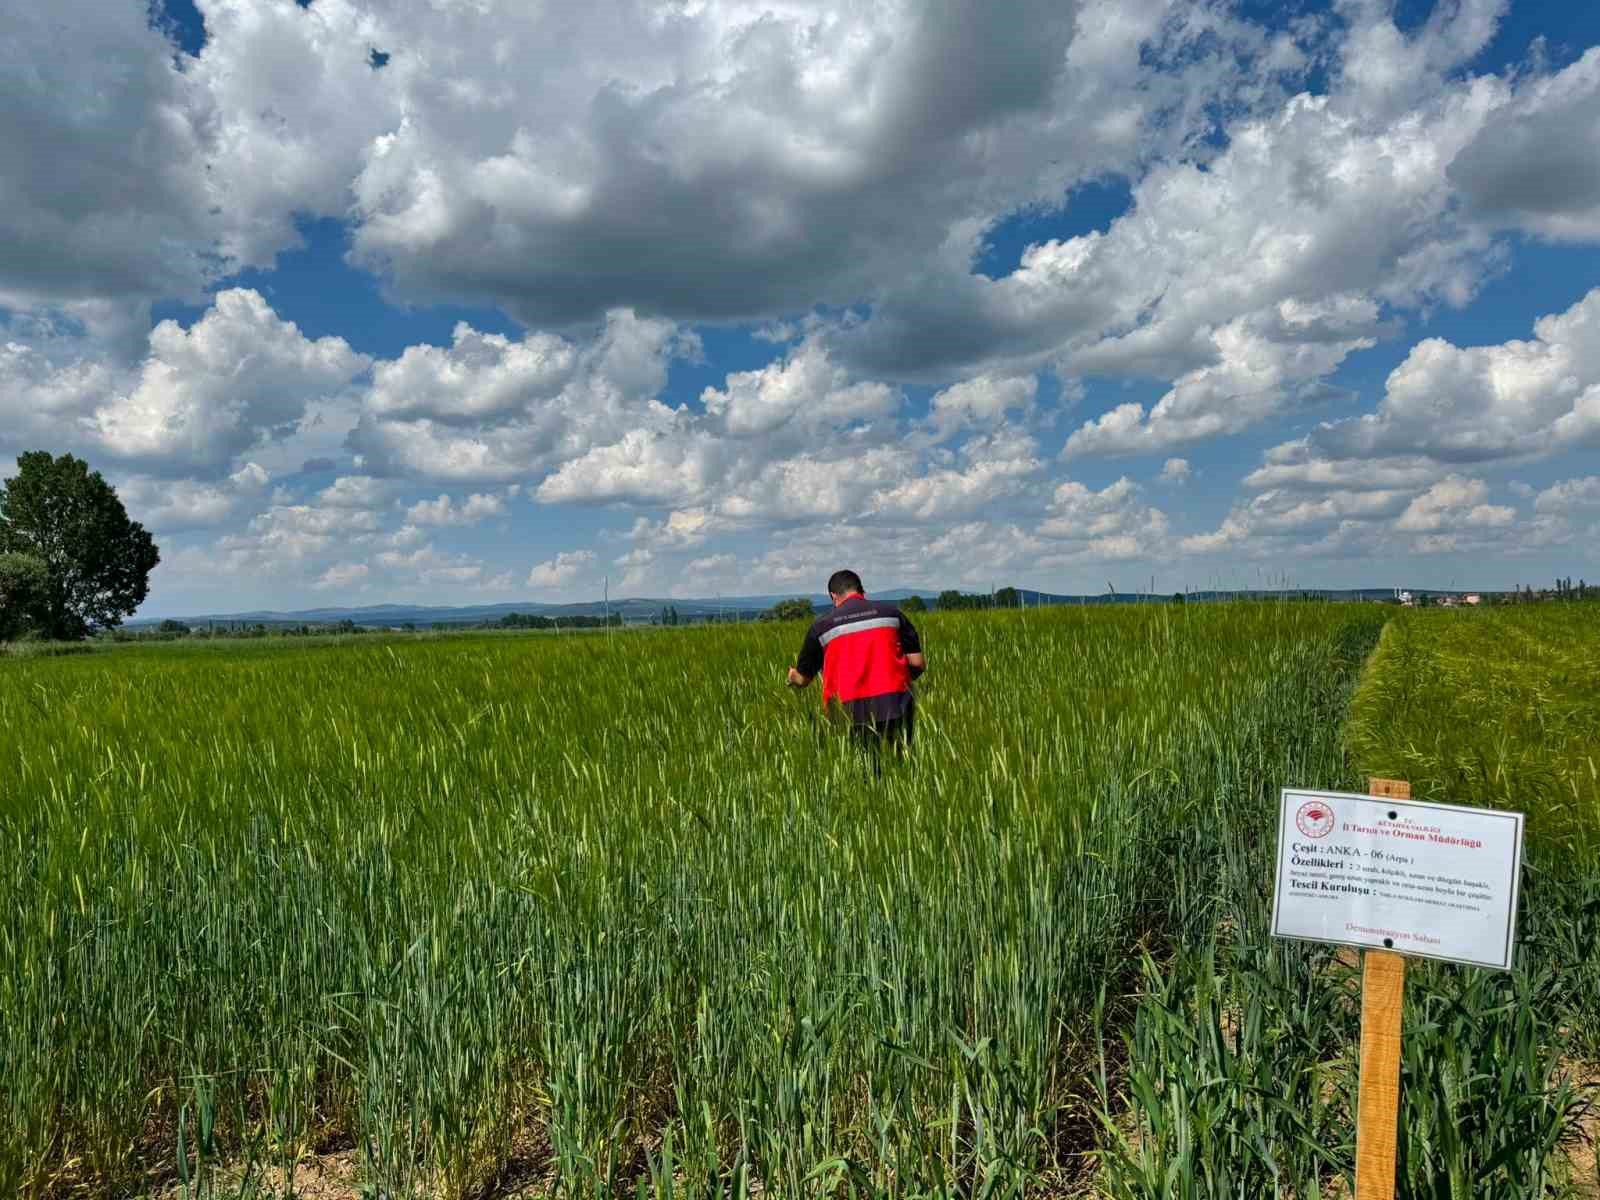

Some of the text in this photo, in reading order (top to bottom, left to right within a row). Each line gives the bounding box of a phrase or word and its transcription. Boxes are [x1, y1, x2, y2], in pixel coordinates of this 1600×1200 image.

[1352, 823, 1377, 835] Tarım
[1392, 829, 1425, 841] Orman
[1428, 834, 1482, 848] Müdürlüğü
[1292, 842, 1317, 854] Çeşit
[1326, 846, 1361, 856] ANKA
[1370, 849, 1384, 859] 06
[1291, 854, 1344, 869] Özellikleri
[1289, 878, 1318, 890] Tescil
[1320, 880, 1370, 896] Kuruluşu
